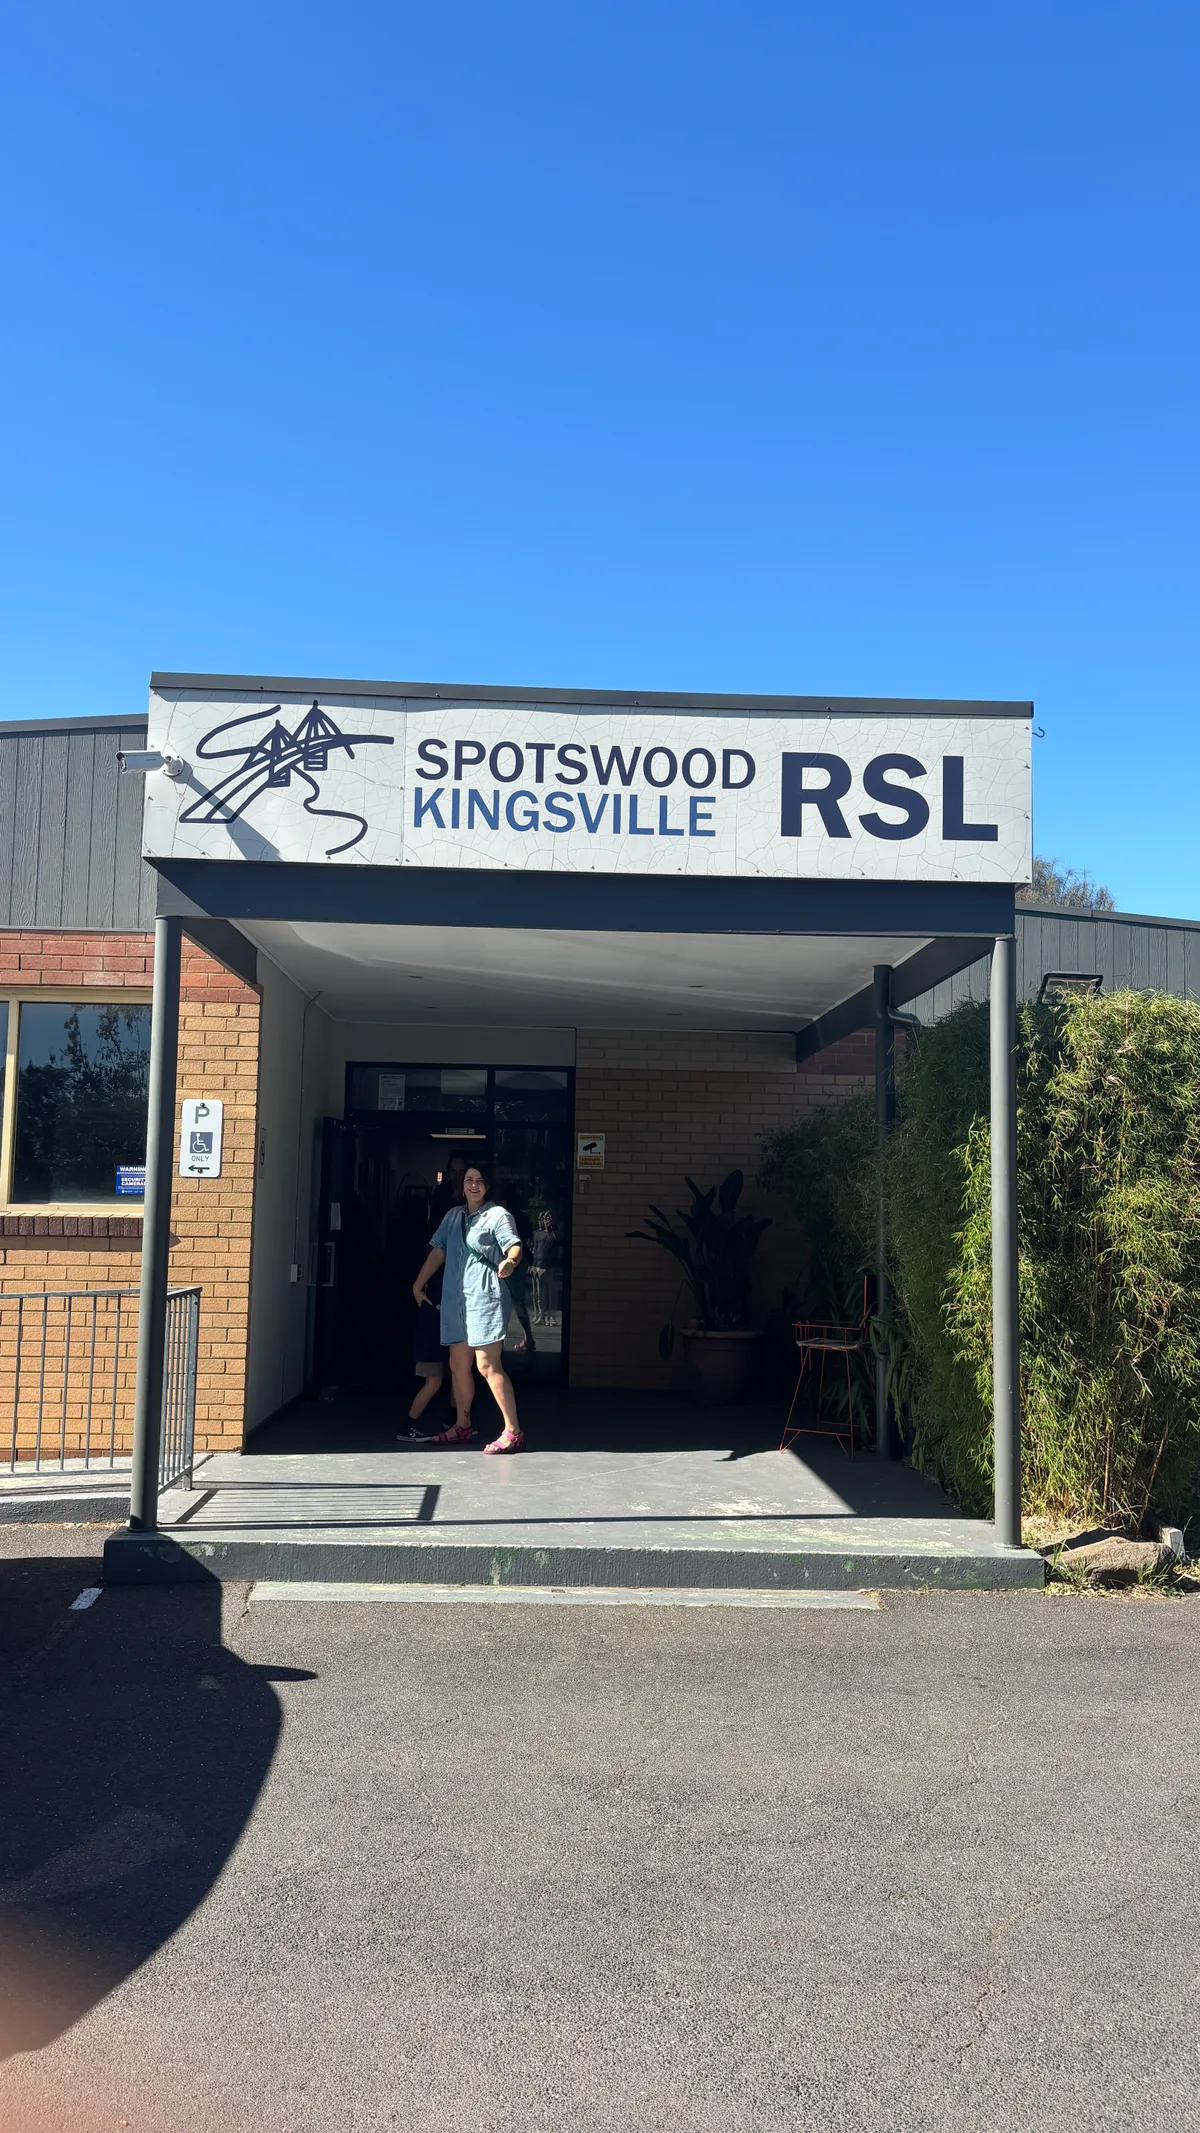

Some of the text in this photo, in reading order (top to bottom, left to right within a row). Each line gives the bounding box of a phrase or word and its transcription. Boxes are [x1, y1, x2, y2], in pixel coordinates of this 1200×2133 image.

[415, 738, 756, 790] SPOTSWOOD
[413, 786, 716, 837] KINGSVILLE
[780, 751, 999, 842] RSL
[195, 1106, 210, 1124] P
